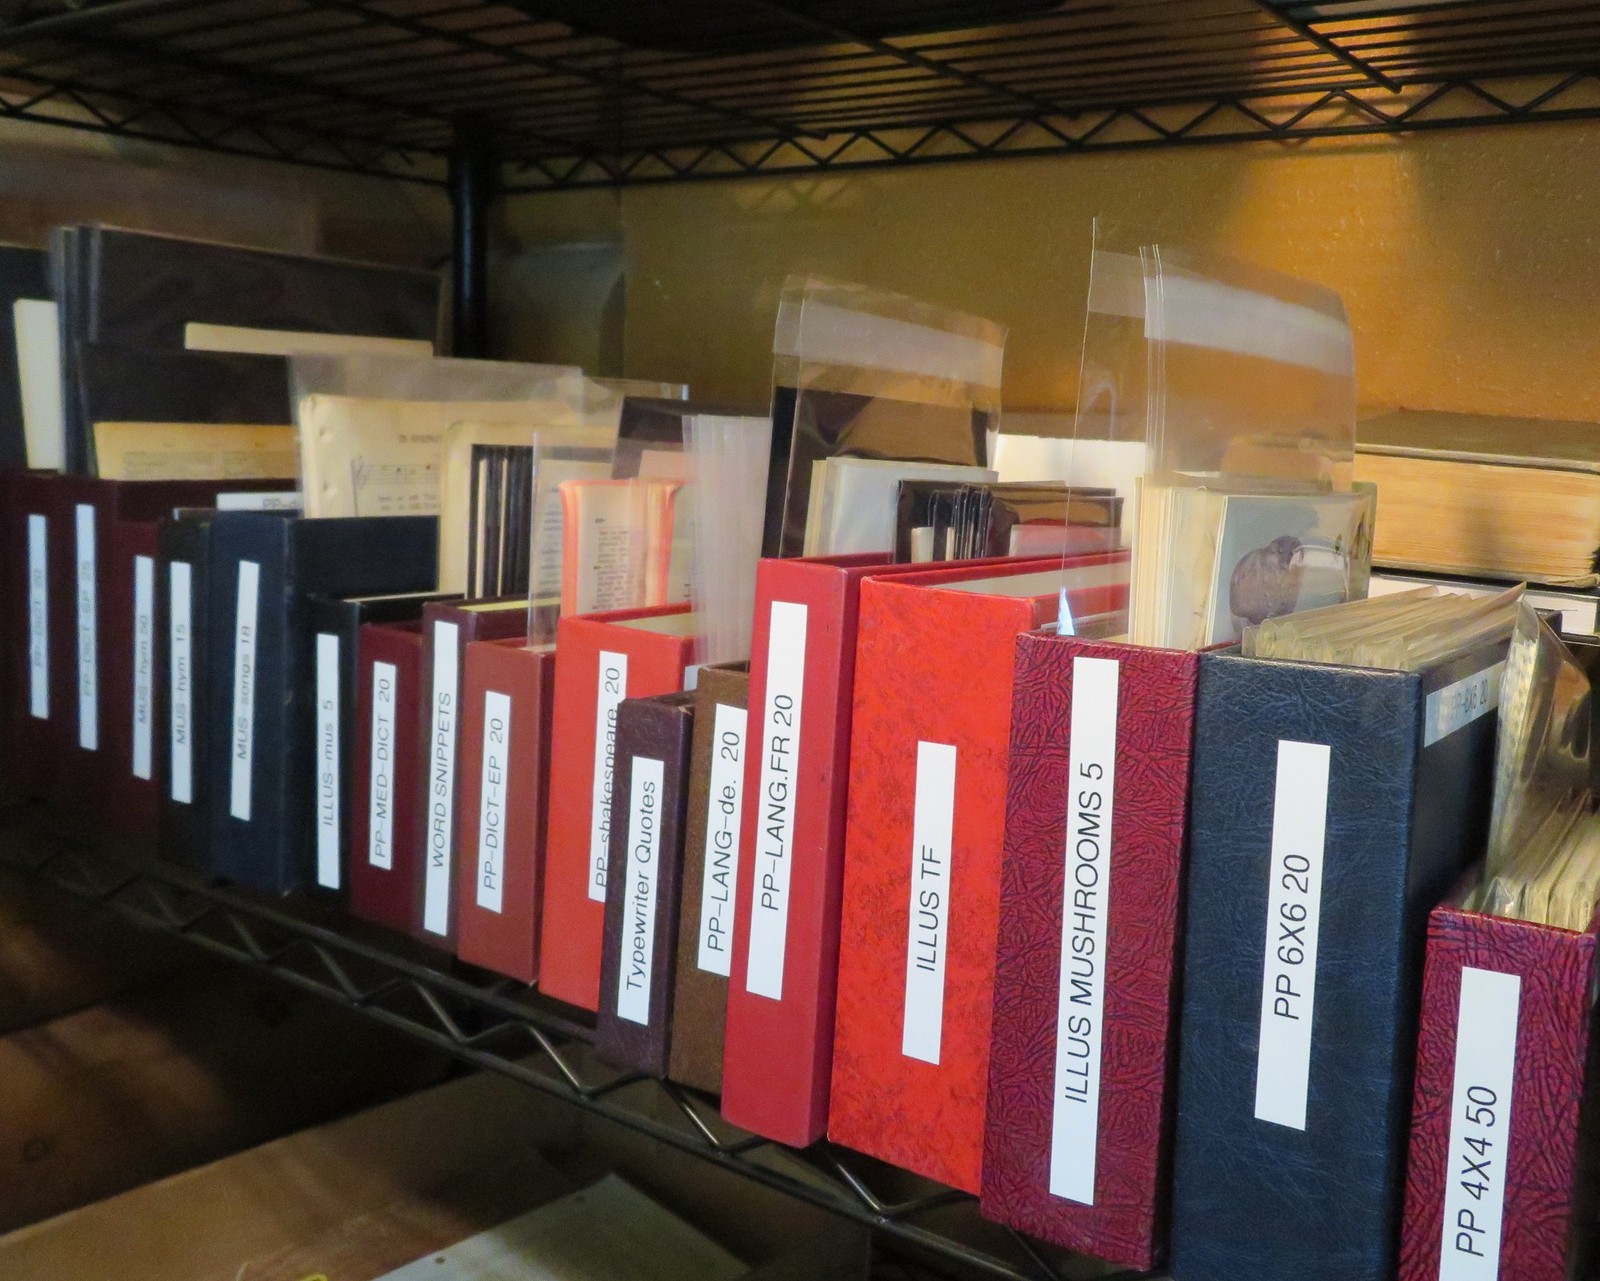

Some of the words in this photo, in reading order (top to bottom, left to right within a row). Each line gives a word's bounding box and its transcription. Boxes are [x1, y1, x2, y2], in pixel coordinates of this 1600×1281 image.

[323, 700, 333, 711] 5
[378, 679, 390, 703] 20
[604, 667, 620, 695] 20
[774, 694, 792, 727] 20
[436, 692, 451, 797] SNIPPETS
[490, 718, 503, 744] 20
[720, 731, 740, 762] 20
[322, 723, 334, 826] ILLUS-mus
[375, 714, 389, 858] PP-MED-DICT
[1080, 762, 1102, 781] 5
[432, 803, 446, 867] WORD
[484, 756, 501, 890] PP-DICT-EP
[635, 780, 656, 864] Quotes
[761, 736, 790, 911] PP-LANG.FR
[920, 845, 941, 880] TF
[1282, 853, 1310, 895] 20
[1070, 791, 1101, 1006] MUSHROOMS
[626, 871, 651, 991] Typewriter
[916, 891, 939, 973] ILLUS
[1277, 901, 1307, 966] 6X6
[1274, 974, 1300, 1021] PP
[1064, 1016, 1092, 1104] ILLUS
[1465, 1084, 1497, 1128] 50
[1459, 1136, 1493, 1201] 4X4
[1455, 1209, 1485, 1258] PP
